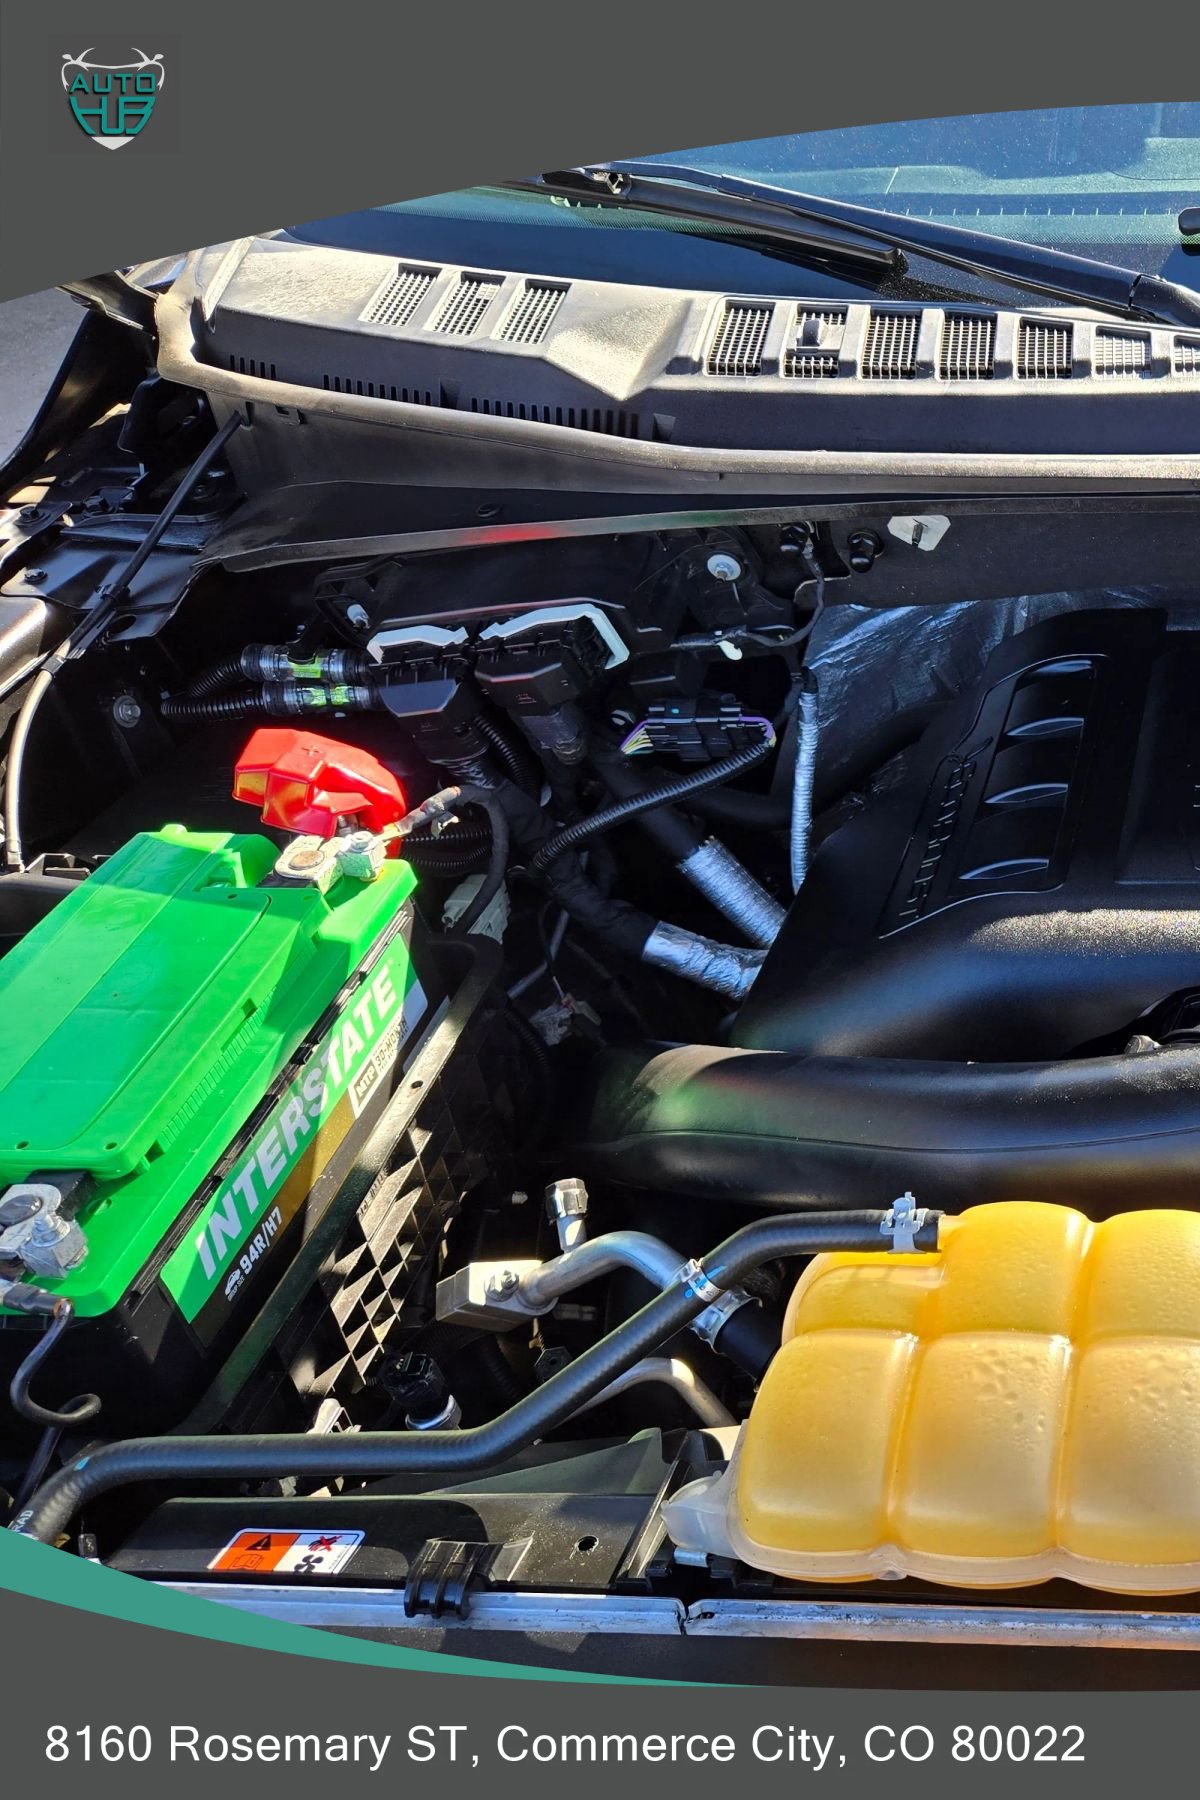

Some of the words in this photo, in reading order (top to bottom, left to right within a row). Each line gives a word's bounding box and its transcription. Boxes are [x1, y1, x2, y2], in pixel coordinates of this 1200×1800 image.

[354, 1064, 377, 1098] MTP
[195, 967, 398, 1280] INTERSTATE
[240, 1206, 282, 1275] 94R/H7
